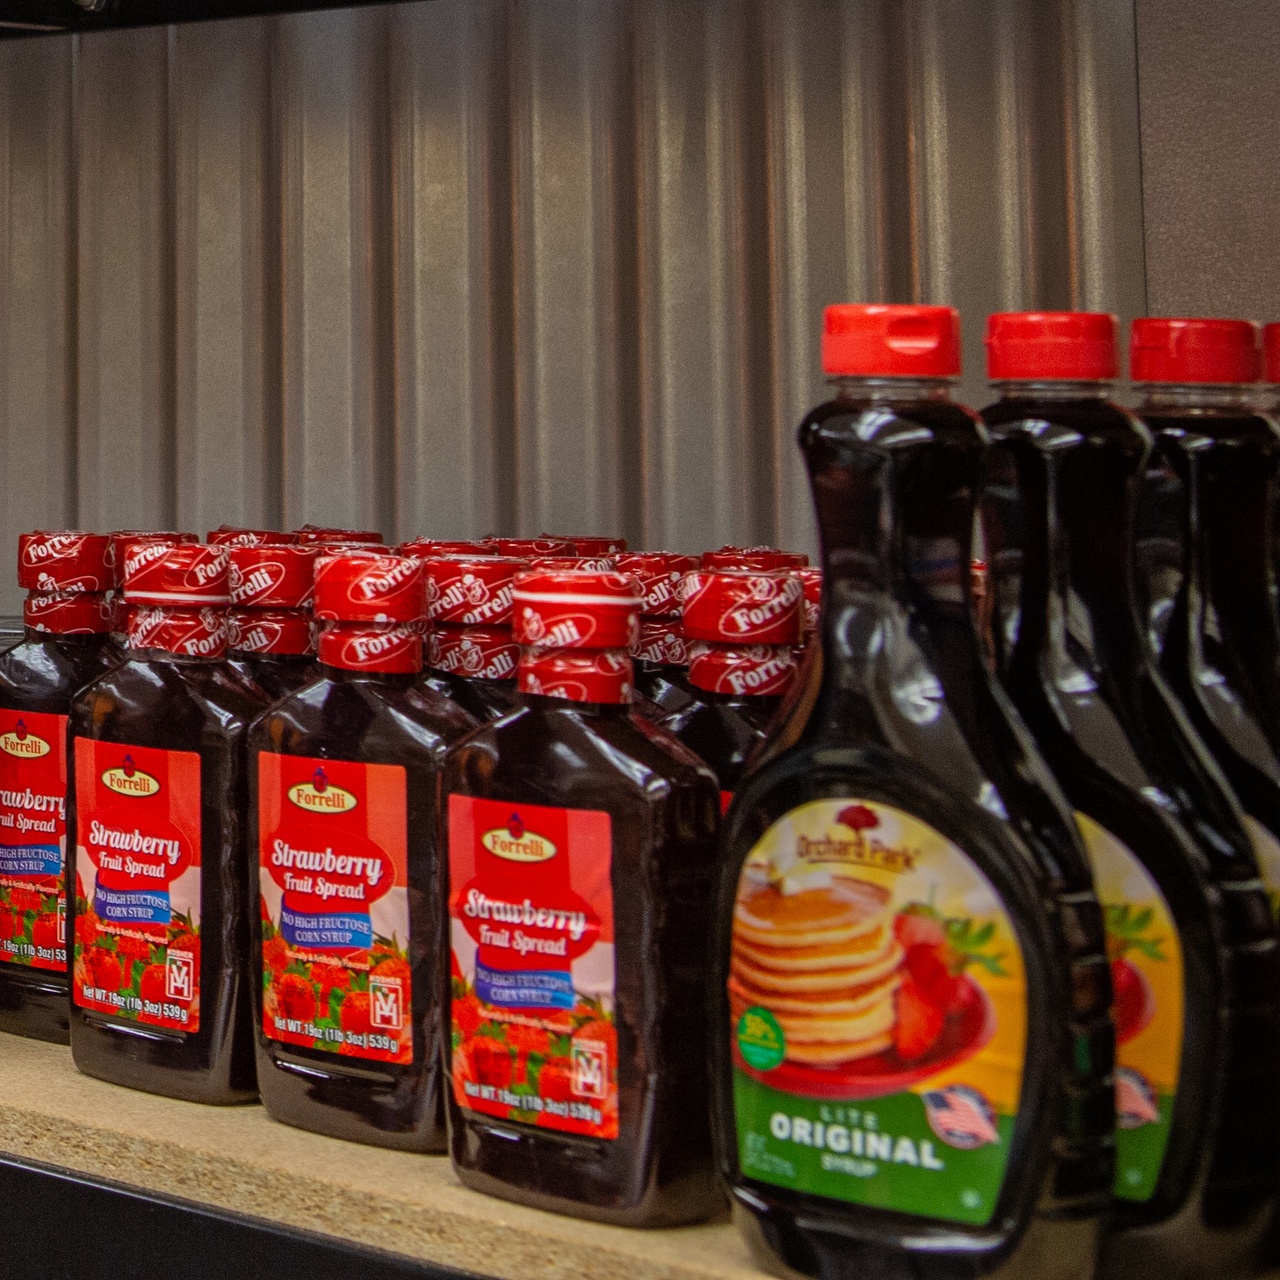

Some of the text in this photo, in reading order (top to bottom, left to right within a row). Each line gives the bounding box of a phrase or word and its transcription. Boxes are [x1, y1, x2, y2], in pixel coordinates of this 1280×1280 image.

[3, 735, 41, 754] Forrelli
[109, 772, 150, 793] Forrelli
[296, 787, 346, 809] Forrelli
[17, 812, 56, 833] Spread
[89, 820, 181, 865] Strawberry
[490, 833, 546, 858] Forrelli
[796, 834, 915, 870] Orchard Park
[0, 846, 13, 859] HIGH
[14, 847, 59, 863] FRUCTOSE
[0, 860, 45, 872] CORN SYRUP
[99, 852, 166, 879] Fruit Spread
[272, 839, 383, 886] Strawberry
[284, 874, 365, 901] Fruit Spread
[96, 890, 169, 911] NO HIGH FRUCTOSE
[106, 906, 154, 920] CORN SYRUP
[282, 911, 370, 934] NO HIGH FRUCTOSE
[464, 888, 586, 940] Strawberry
[295, 930, 352, 945] CORN SYRUP
[479, 925, 566, 956] Fruit Spread
[167, 947, 194, 959] KOSHER
[369, 974, 401, 985] KOSHER
[83, 986, 94, 1000] Net
[143, 1000, 162, 1017] 3oz)
[770, 1112, 945, 1171] ORIGINAL
[821, 1155, 878, 1178] SYRUP
